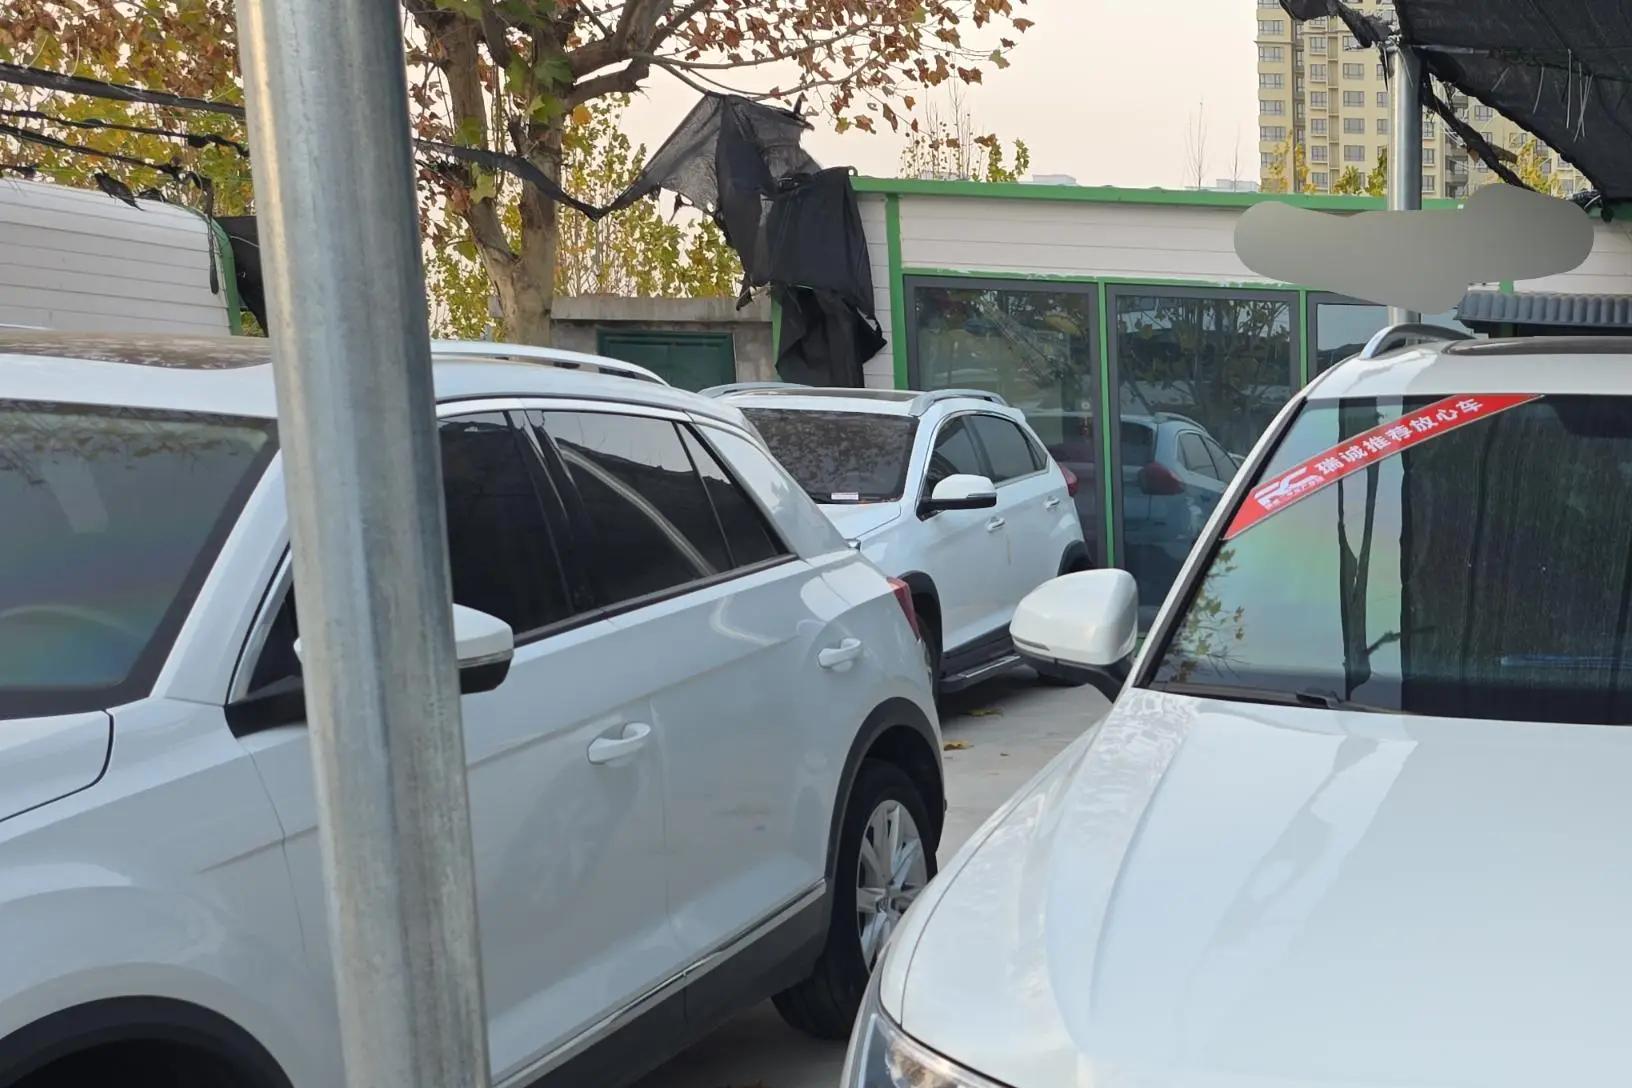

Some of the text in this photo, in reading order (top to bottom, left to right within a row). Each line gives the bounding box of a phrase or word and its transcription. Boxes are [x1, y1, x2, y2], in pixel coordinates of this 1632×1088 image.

[1315, 398, 1484, 475] 瑞诚推荐放心车
